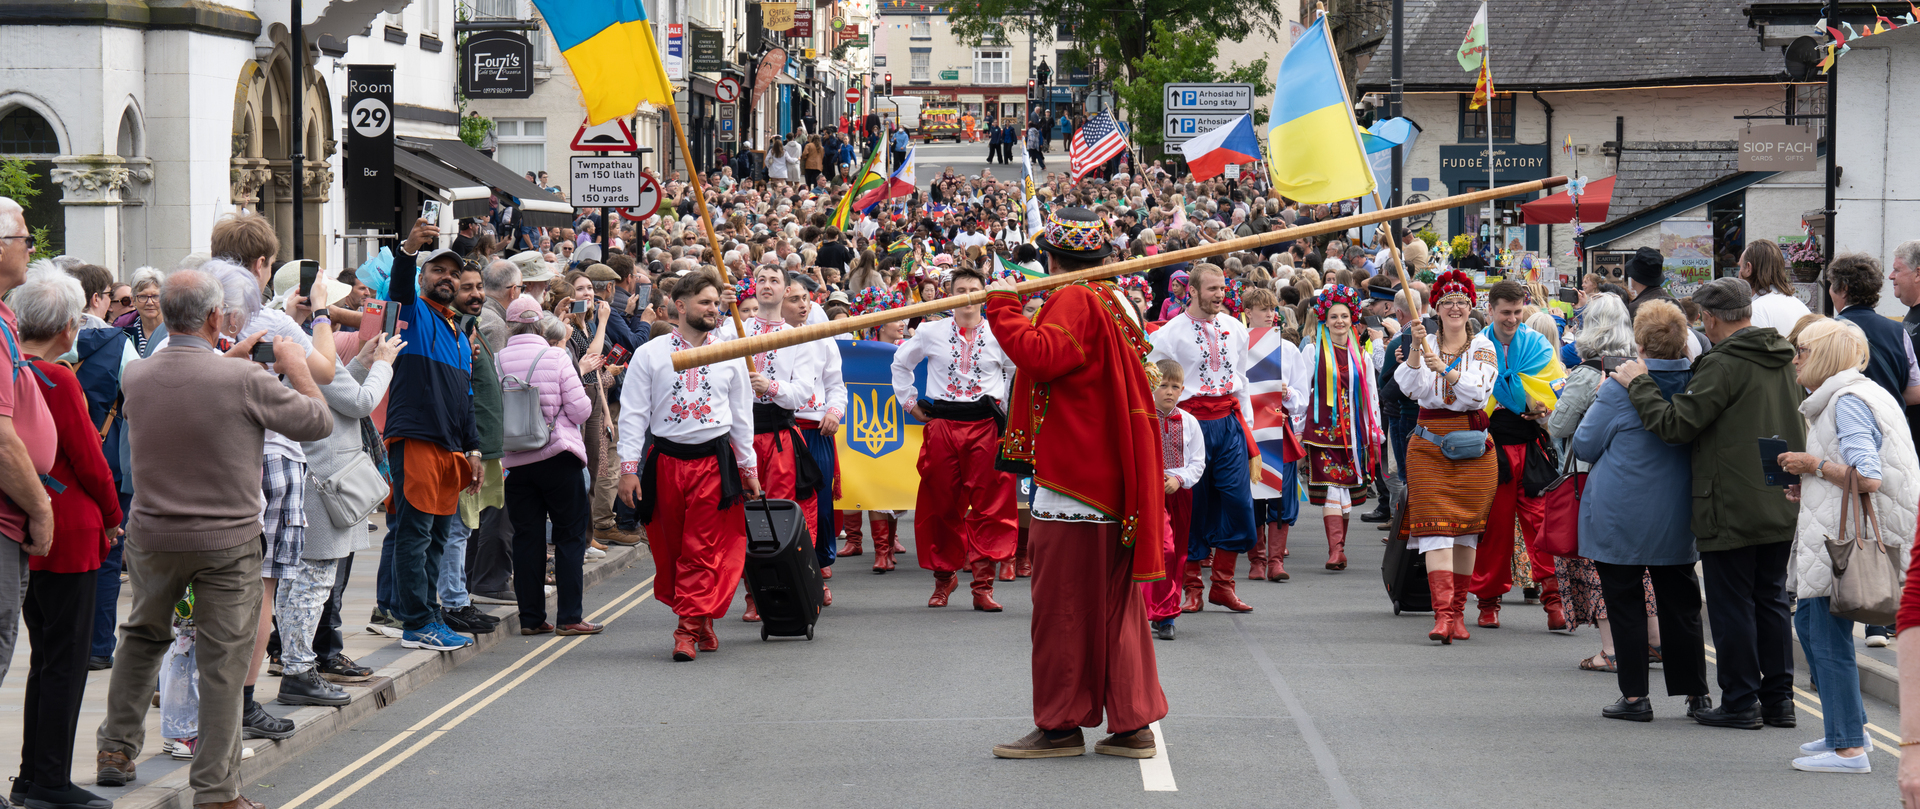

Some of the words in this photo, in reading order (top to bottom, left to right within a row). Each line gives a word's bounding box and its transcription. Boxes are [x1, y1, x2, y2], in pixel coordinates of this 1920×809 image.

[350, 79, 392, 93] Room
[356, 107, 386, 128] 29
[1743, 142, 1774, 153] SIOP
[1777, 142, 1813, 153] FACH
[577, 160, 633, 170] Twmpathau
[1442, 158, 1483, 168] FUDGE
[1491, 157, 1543, 168] ACTORY
[364, 168, 378, 177] Bar
[592, 170, 610, 179] 150
[613, 170, 635, 179] llath
[589, 184, 622, 193] Humps
[582, 193, 600, 202] 150
[602, 194, 629, 204] yards
[1680, 267, 1710, 278] WALES
